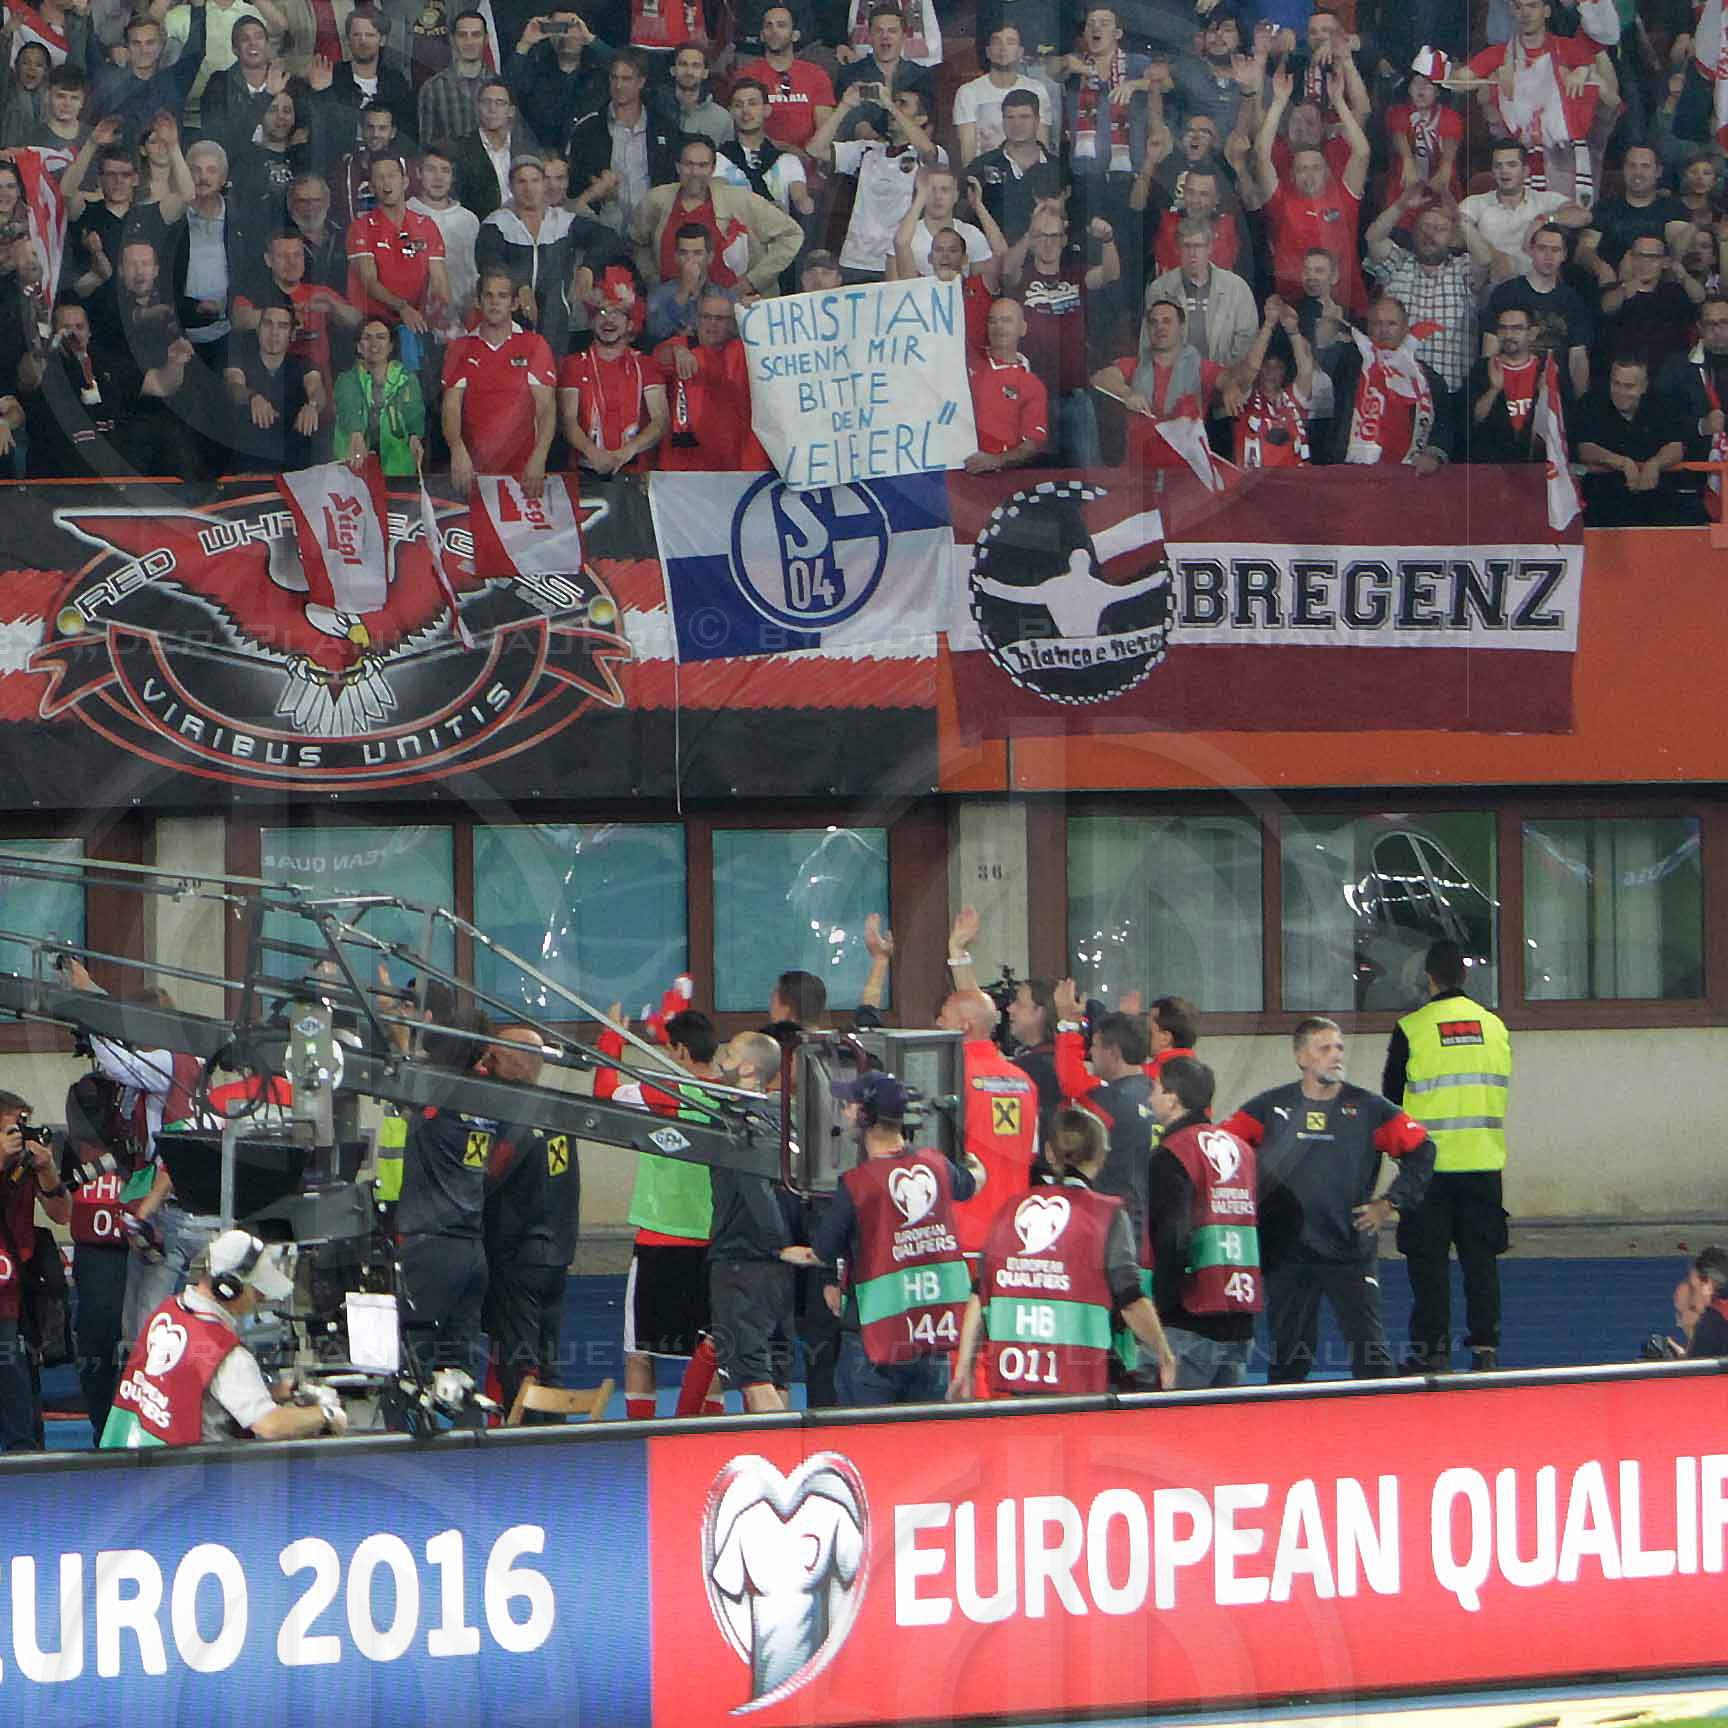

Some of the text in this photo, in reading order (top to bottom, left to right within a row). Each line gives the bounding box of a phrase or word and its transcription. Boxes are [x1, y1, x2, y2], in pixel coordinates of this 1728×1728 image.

[744, 285, 954, 347] CHRISTIAN
[757, 335, 926, 382] SCHENK MIR
[799, 372, 889, 413] BITTE
[832, 407, 876, 433] DEN
[74, 548, 177, 621] RED
[1177, 558, 1568, 631] BREGENZ
[142, 676, 513, 768] VIRIBUS UNITIS
[903, 1271, 941, 1302] HB
[1015, 1304, 1056, 1338] HB
[999, 1346, 1059, 1384] 011
[893, 1453, 1728, 1627] EUROPEAN QUALIF
[275, 1523, 556, 1668] 2016
